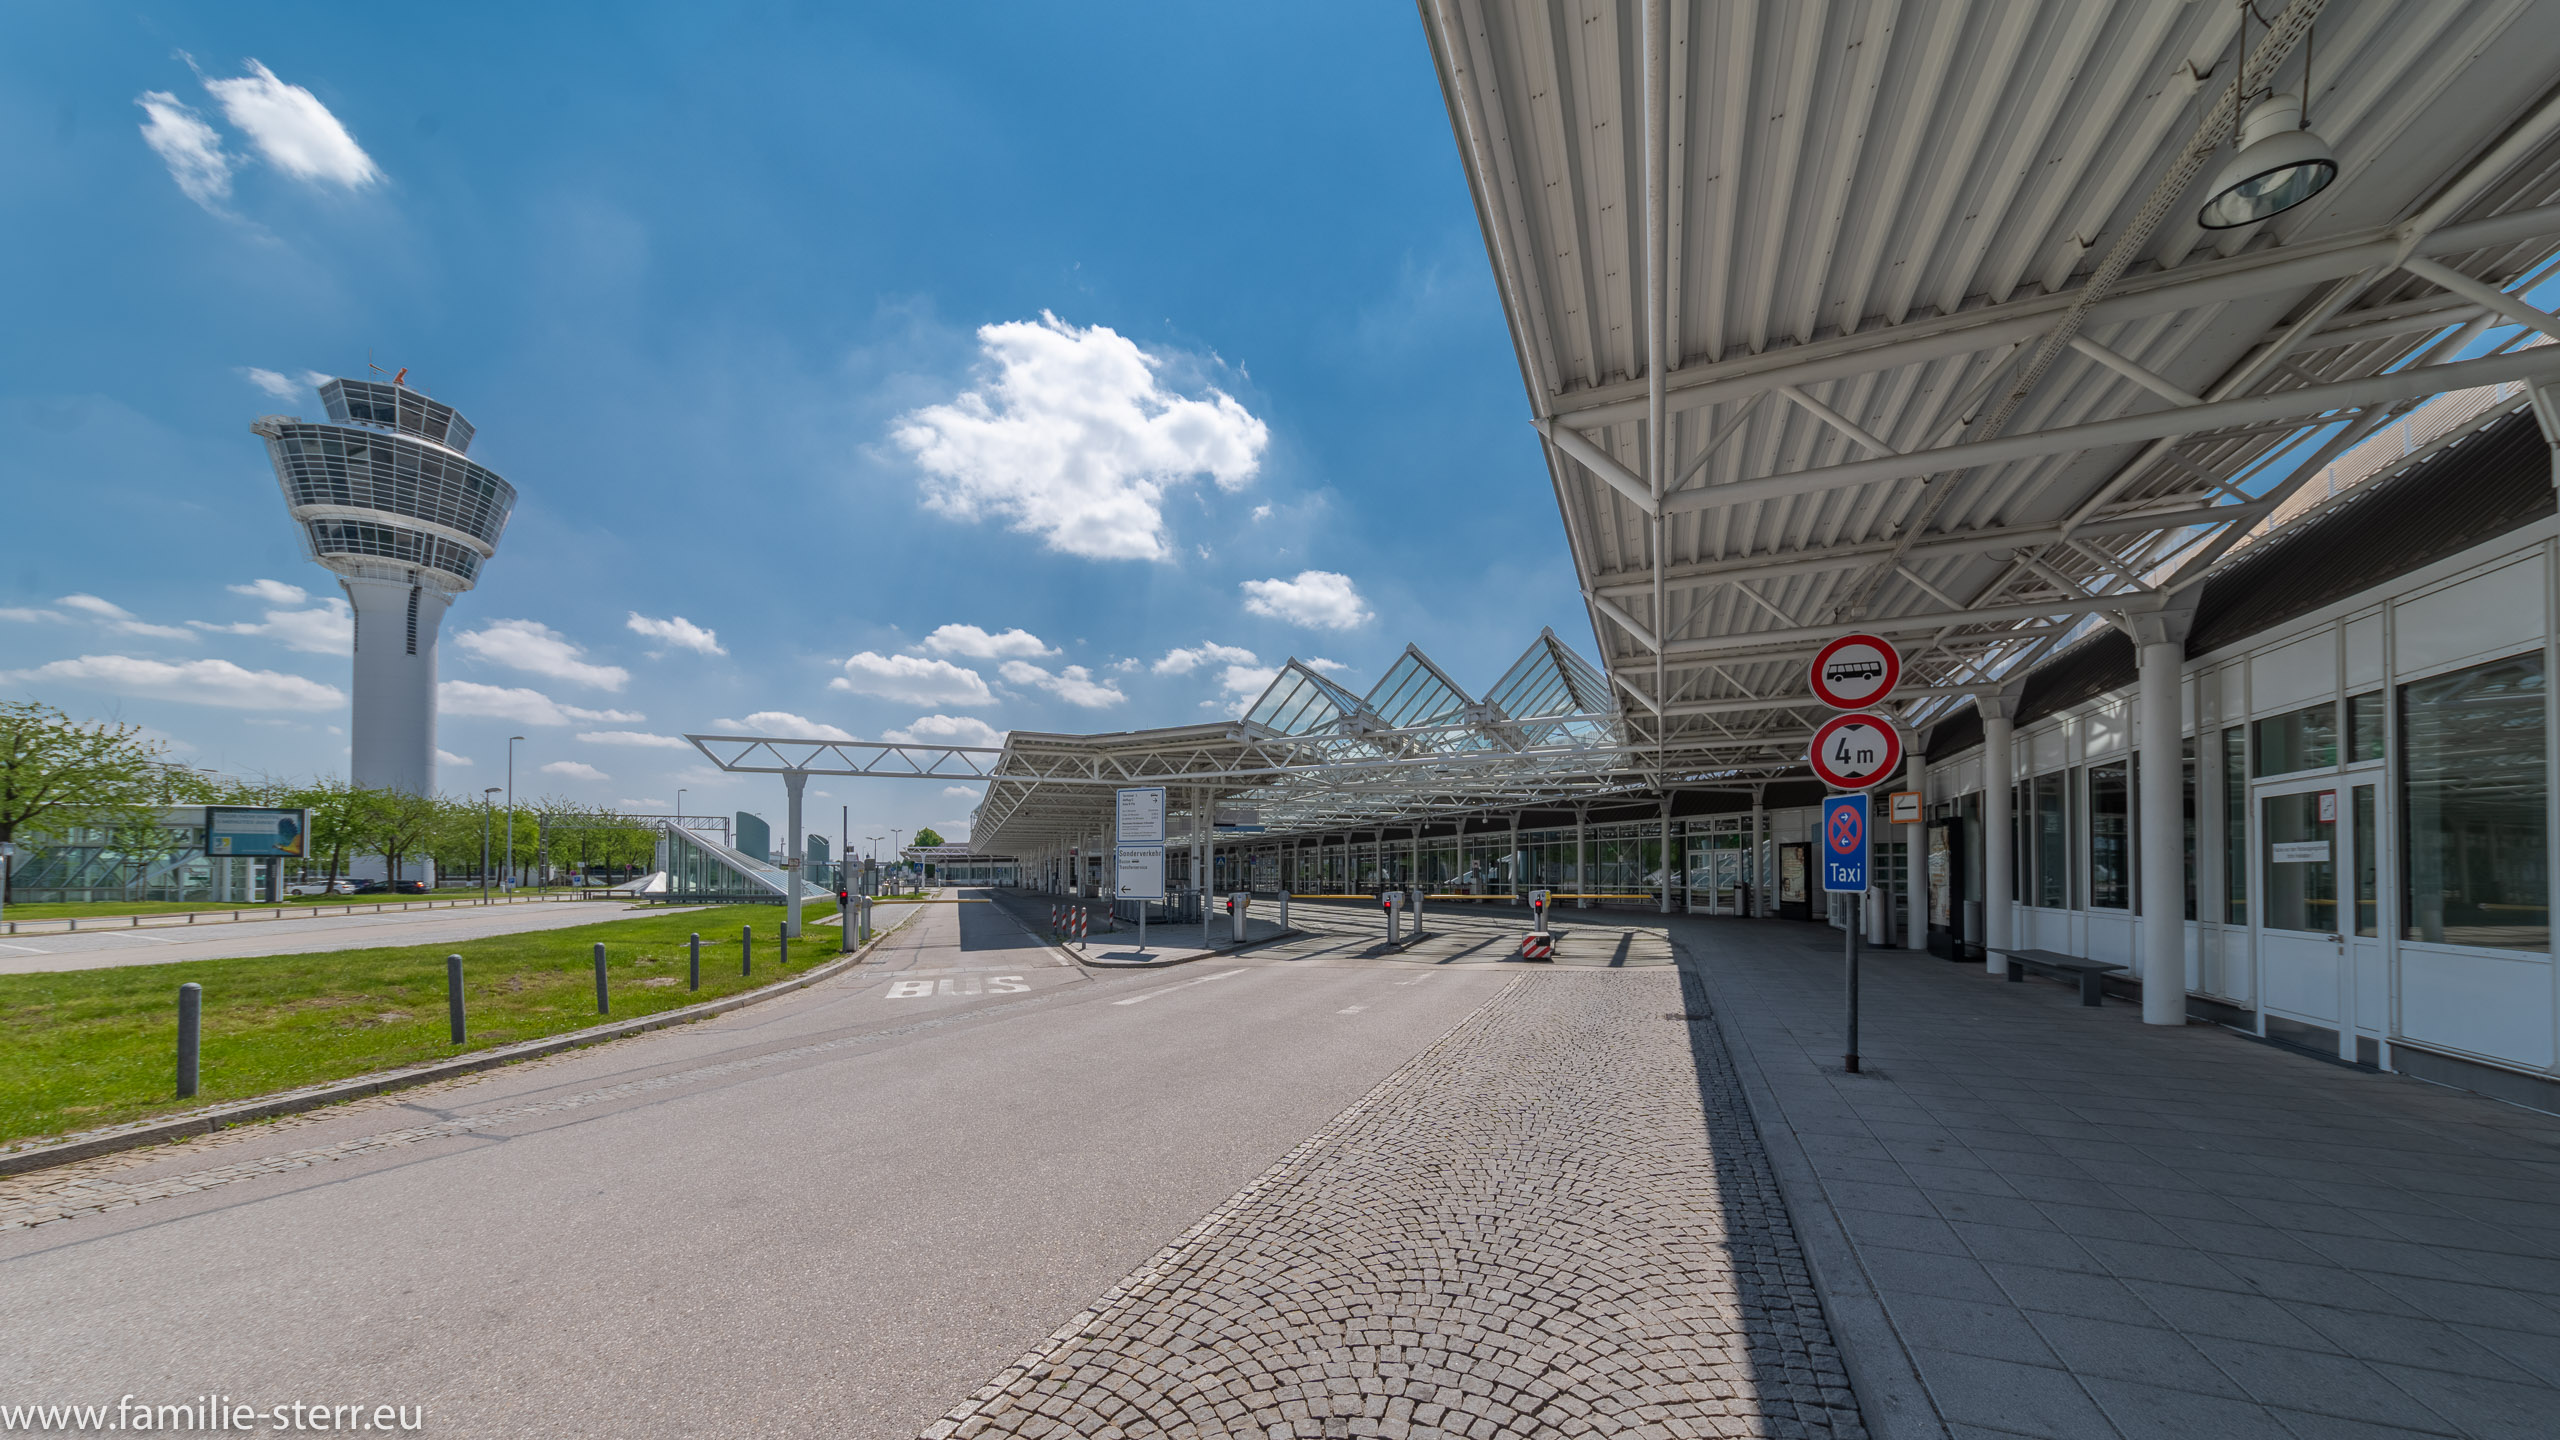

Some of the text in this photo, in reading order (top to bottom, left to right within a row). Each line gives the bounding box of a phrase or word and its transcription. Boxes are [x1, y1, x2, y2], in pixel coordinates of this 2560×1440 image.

[1835, 737, 1874, 765] 4 m
[1830, 862, 1861, 883] Taxi
[884, 975, 1032, 999] BUS
